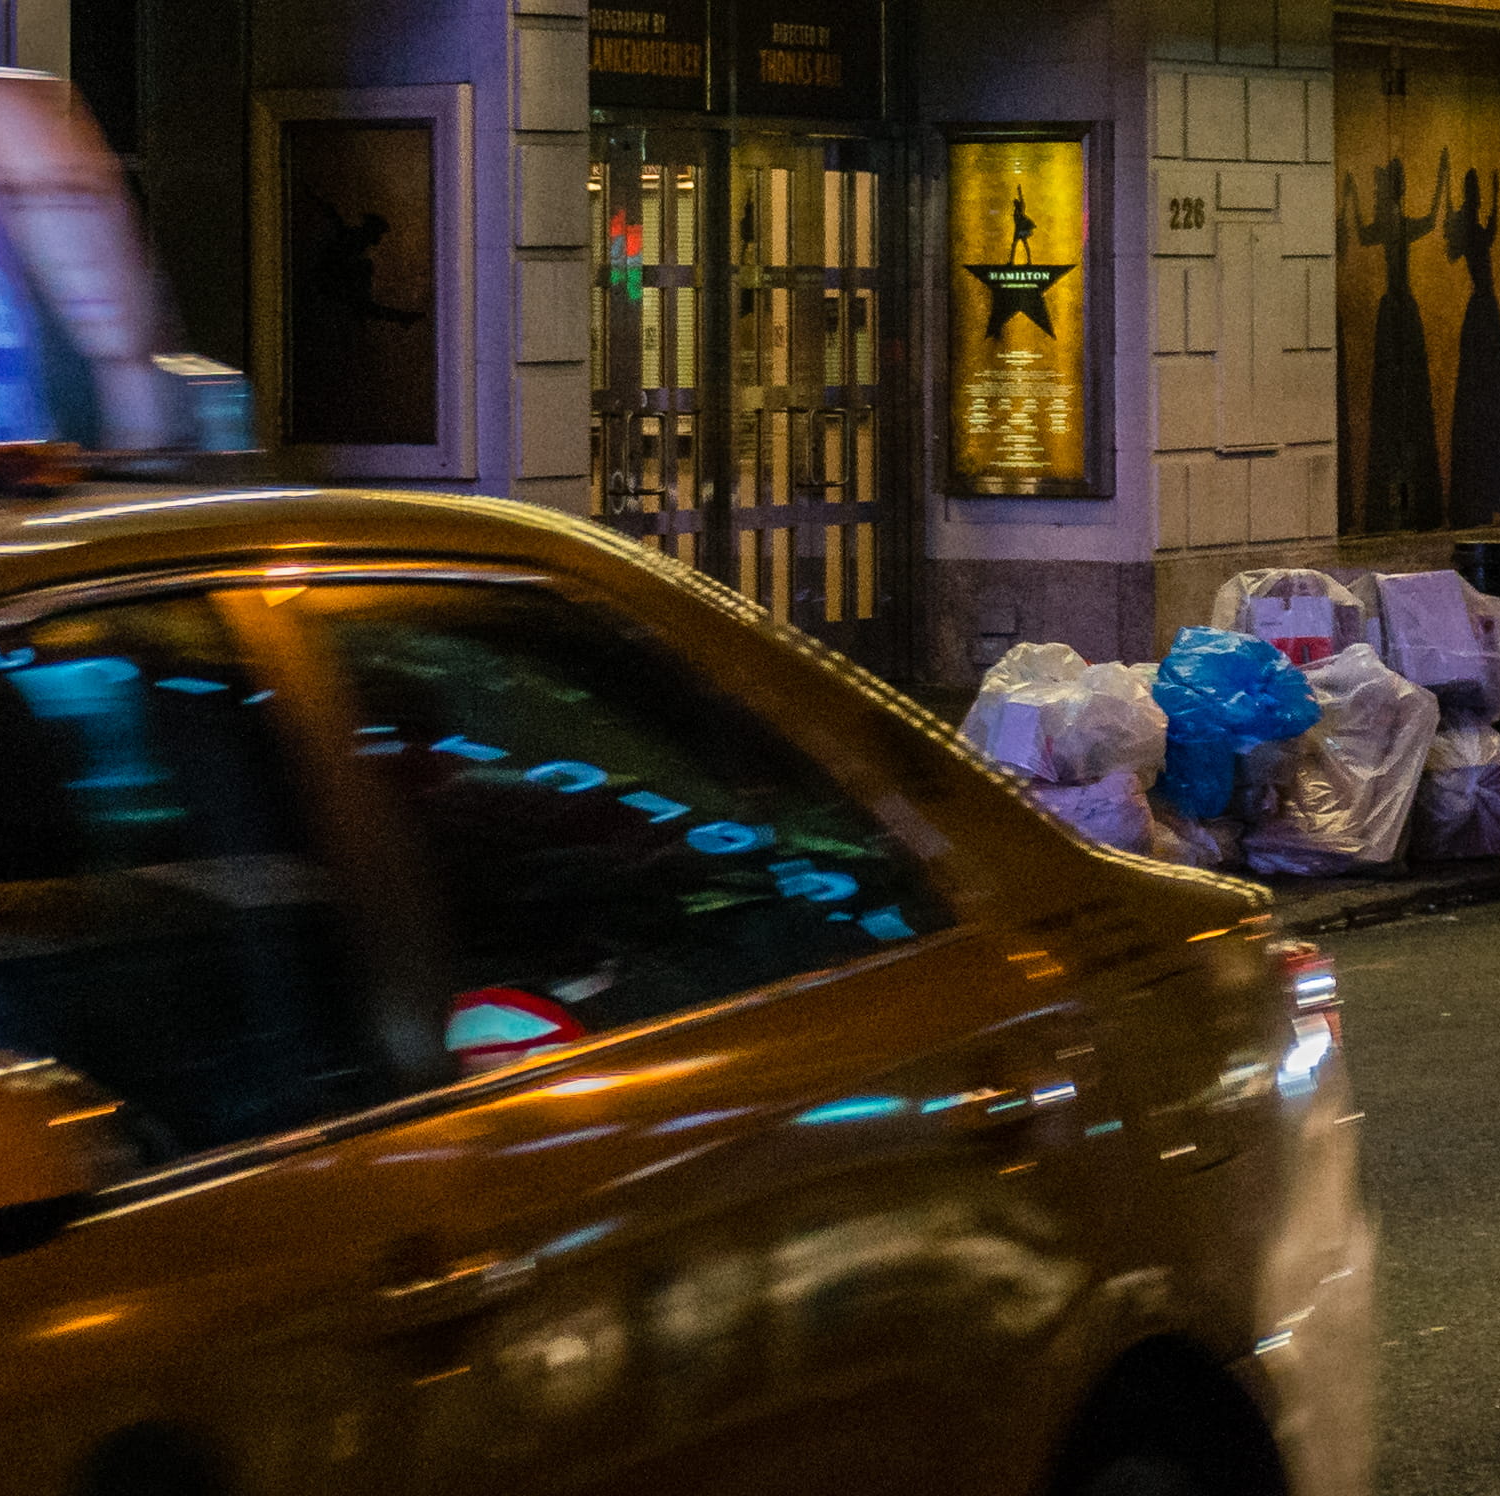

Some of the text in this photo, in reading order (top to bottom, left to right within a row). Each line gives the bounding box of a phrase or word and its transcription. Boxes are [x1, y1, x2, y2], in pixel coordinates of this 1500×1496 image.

[652, 12, 667, 34] BY
[772, 22, 831, 47] DIRECTED BY
[759, 49, 813, 85] THOMAS
[1170, 196, 1205, 230] 226
[988, 270, 1050, 281] HAMILTON
